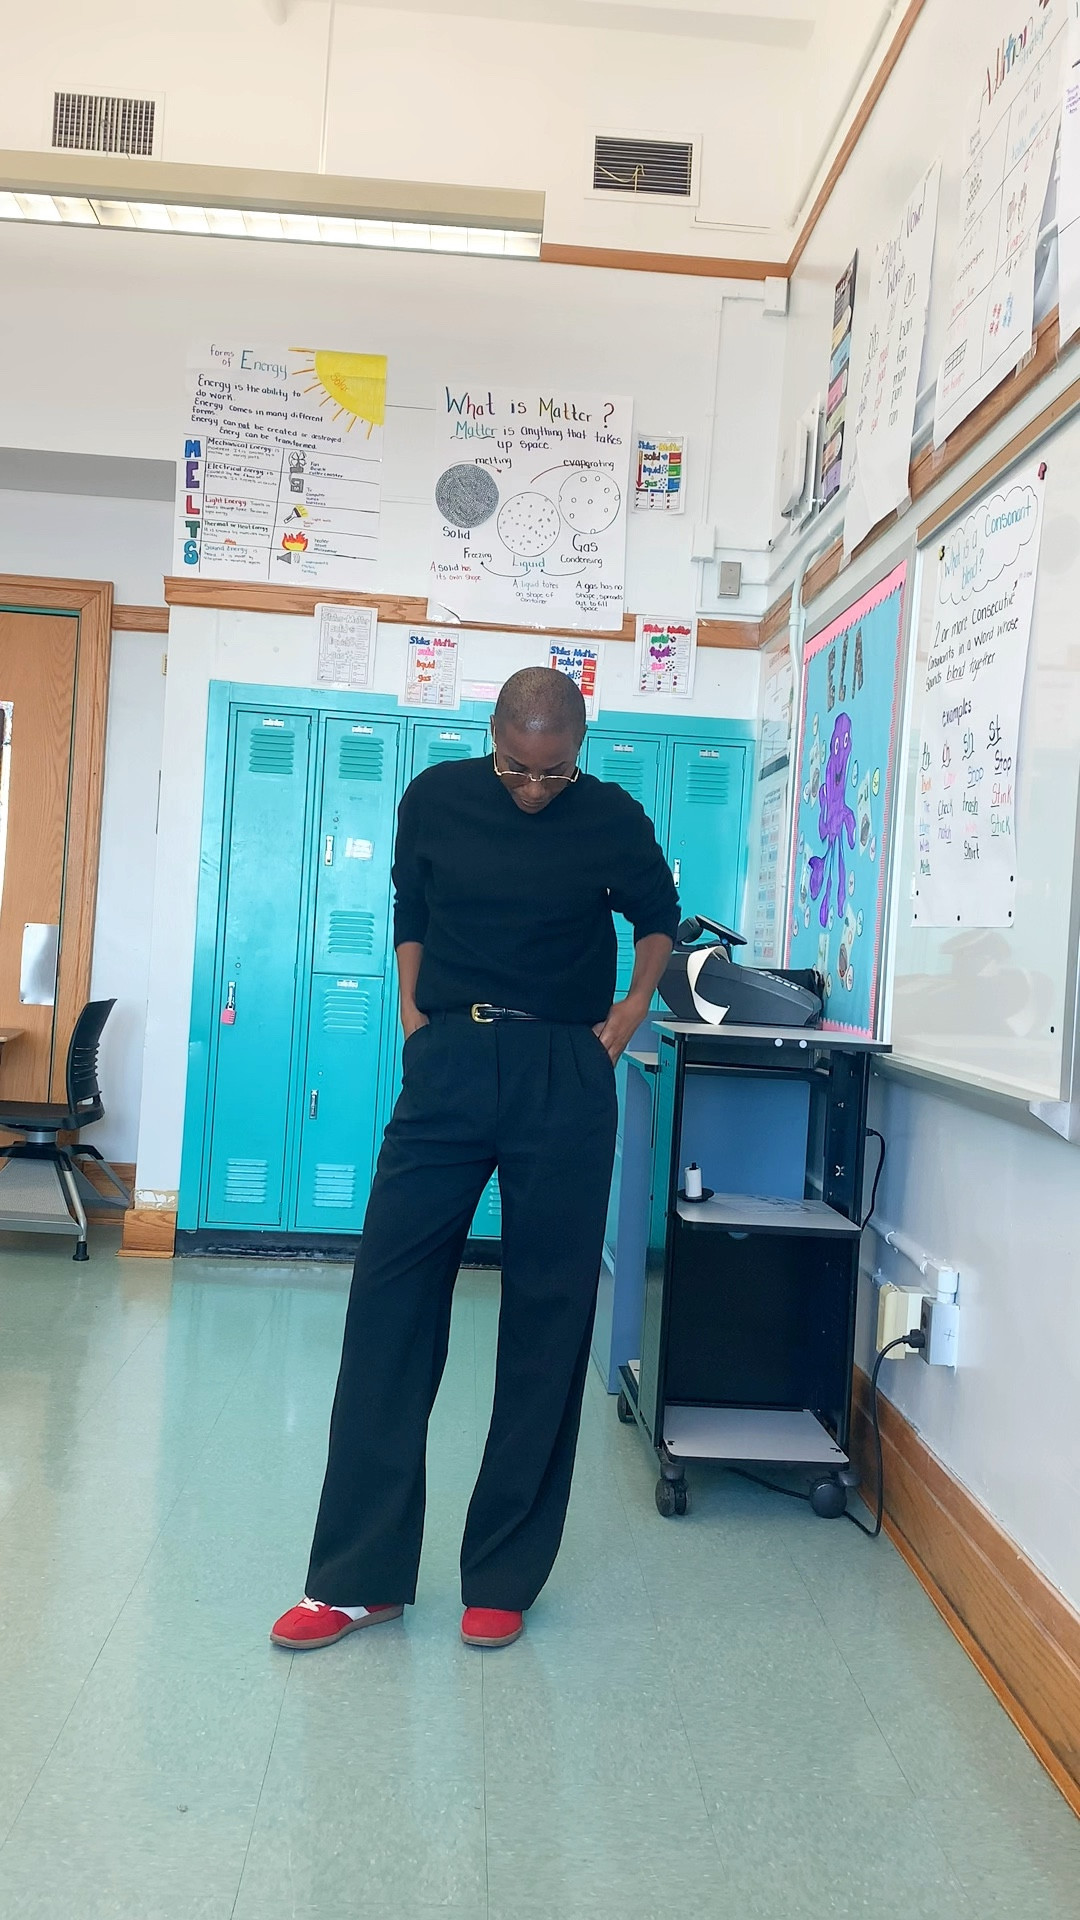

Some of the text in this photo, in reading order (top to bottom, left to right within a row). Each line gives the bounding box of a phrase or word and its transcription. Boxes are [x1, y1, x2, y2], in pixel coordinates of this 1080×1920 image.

[222, 357, 231, 367] of
[240, 349, 287, 381] Energy
[195, 389, 207, 397] do
[198, 373, 231, 393] Energy
[246, 383, 260, 393] the
[261, 386, 289, 401] ability
[293, 390, 302, 398] to
[194, 396, 224, 411] Energy
[265, 409, 288, 420] many
[290, 411, 323, 422] different
[445, 386, 496, 420] What
[510, 399, 527, 414] is
[539, 396, 592, 423] Matter
[191, 414, 219, 426] Energy
[267, 426, 298, 437] created
[455, 420, 498, 439] Matter
[503, 425, 515, 436] is
[520, 425, 563, 441] anything
[567, 428, 587, 440] that
[207, 437, 248, 449] Mechanical
[249, 444, 272, 454] Energy
[497, 440, 513, 454] up
[475, 456, 512, 469] melting
[643, 451, 661, 461] solid
[207, 462, 242, 472] Electrical
[243, 467, 264, 476] Energy
[643, 464, 661, 476] liquid
[644, 479, 658, 488] gas
[205, 494, 223, 506] Light
[224, 498, 247, 507] Energy
[251, 525, 269, 533] Energy
[972, 528, 978, 550] a
[984, 494, 1032, 538] Consonant
[442, 525, 471, 540] Solid
[205, 543, 225, 552] Sound
[226, 546, 248, 555] Energy
[572, 533, 598, 552] Gas
[463, 547, 493, 562] Freezing
[560, 554, 603, 568] Condensing
[430, 561, 436, 572] A
[461, 564, 472, 572] has
[512, 554, 545, 571] Liquid
[512, 578, 518, 588] A
[521, 580, 539, 591] liquid
[575, 580, 582, 589] A
[584, 582, 598, 593] gas
[600, 581, 613, 590] has
[526, 591, 543, 600] shape
[599, 593, 623, 601] spreads
[575, 600, 587, 608] out
[933, 621, 941, 649] 2
[941, 628, 949, 643] or
[950, 616, 968, 638] more
[958, 643, 965, 656] in
[966, 639, 972, 651] a
[416, 659, 435, 670] liquid
[557, 656, 575, 667] solid
[946, 660, 967, 681] blend
[968, 652, 996, 682] together
[827, 626, 864, 713] ELA
[417, 674, 431, 683] gas
[994, 749, 1012, 776] Stop
